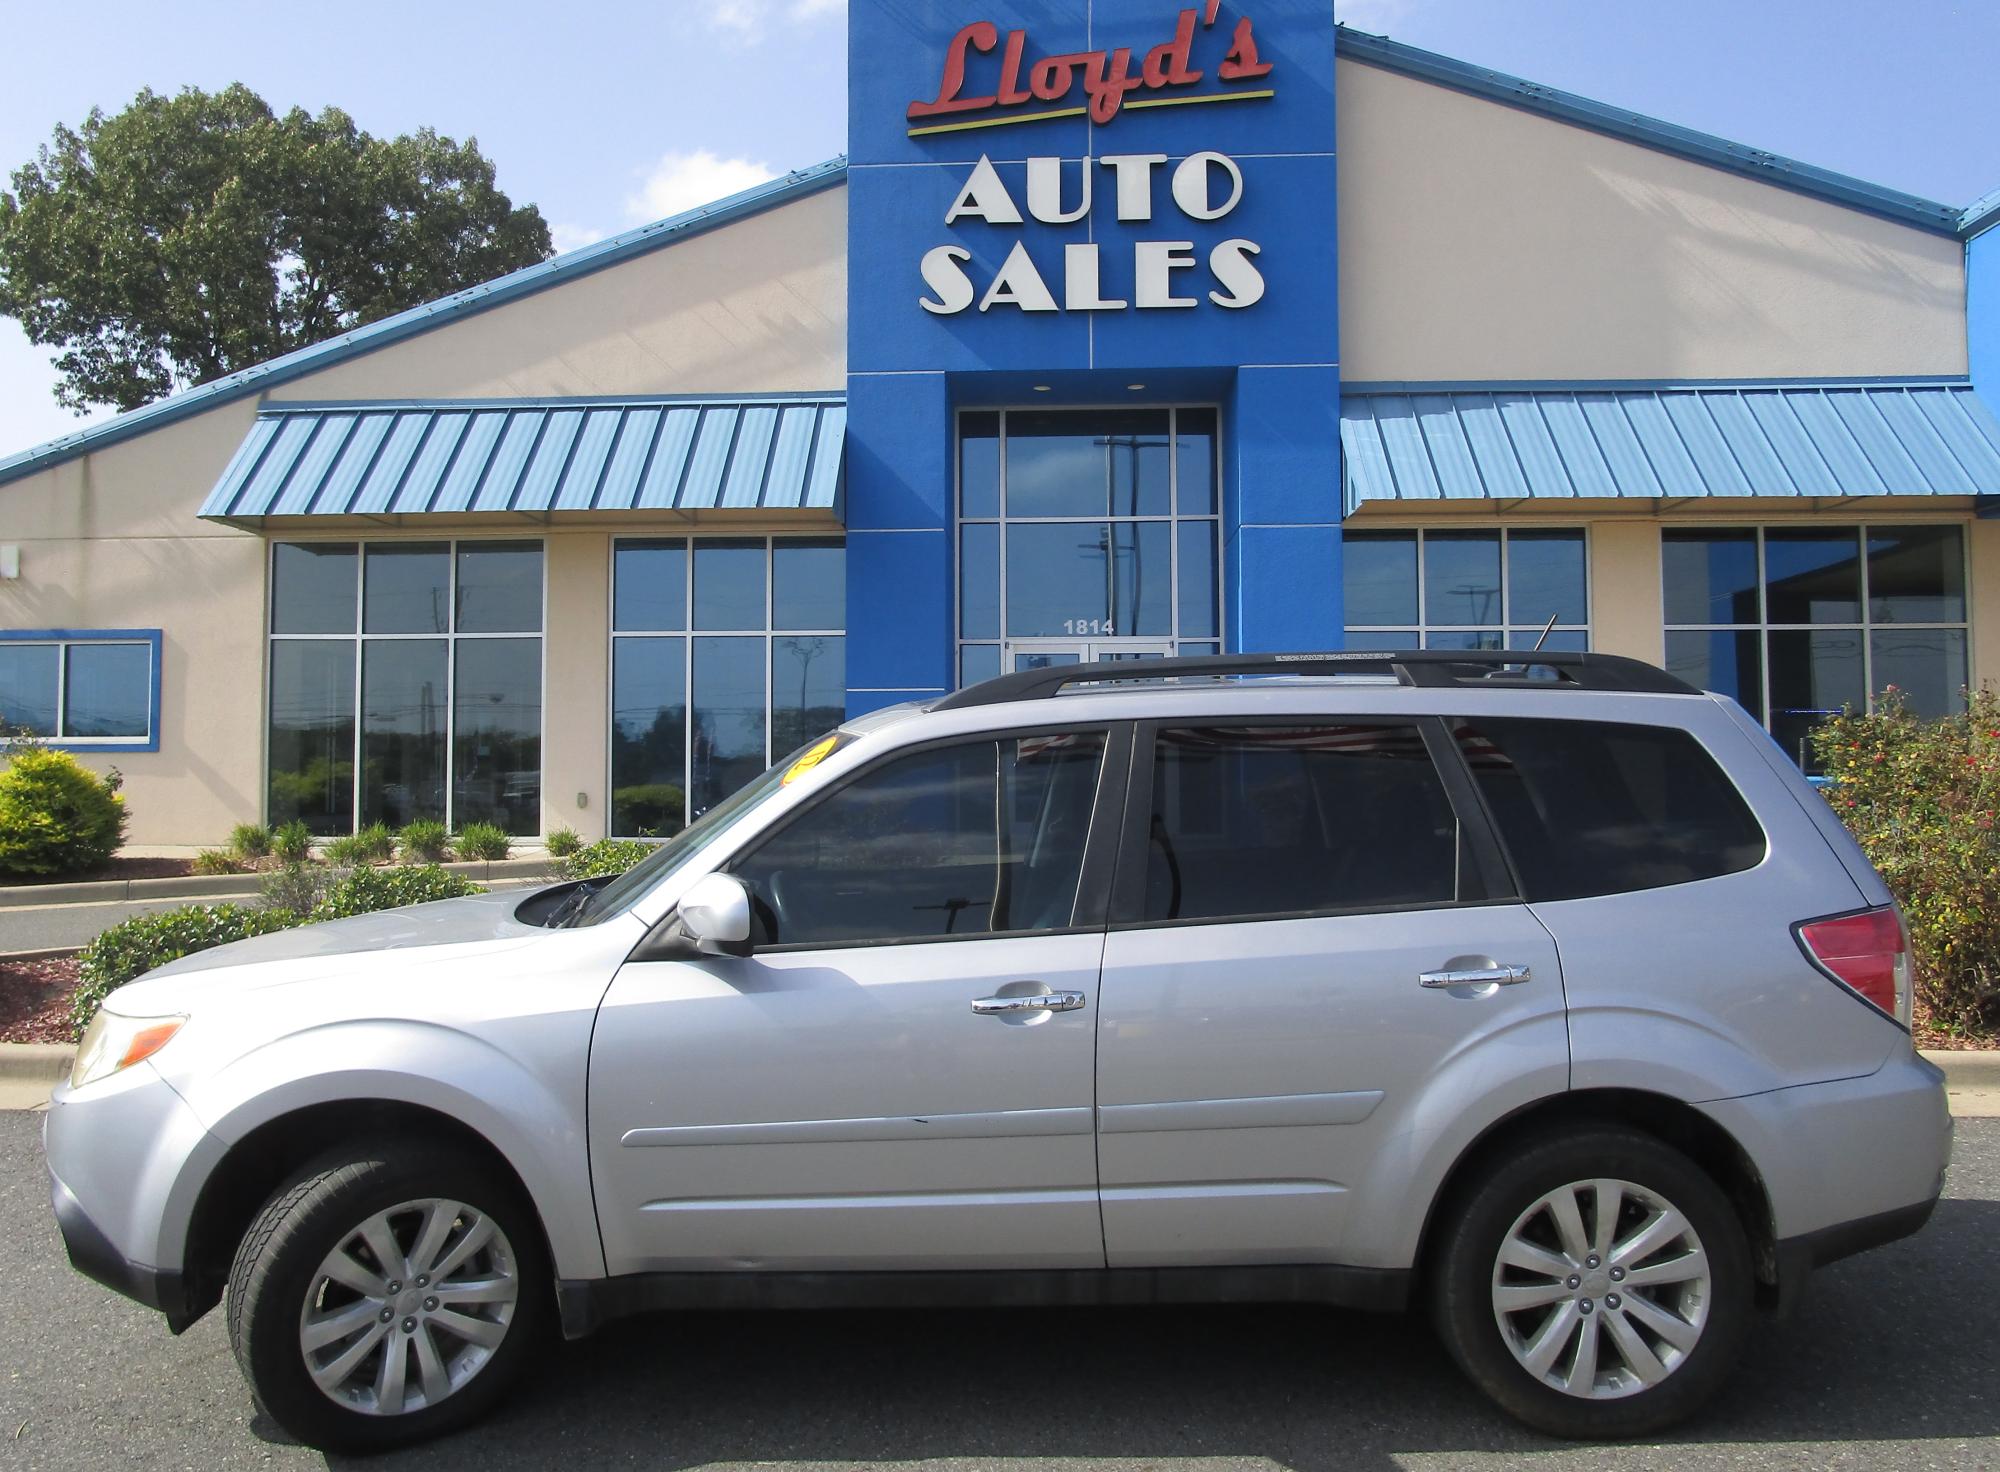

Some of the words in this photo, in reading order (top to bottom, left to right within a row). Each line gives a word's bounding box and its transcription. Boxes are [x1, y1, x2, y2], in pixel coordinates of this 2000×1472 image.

[906, 0, 1274, 126] Lloyd's
[944, 151, 1243, 224] AUTO
[918, 238, 1265, 314] SALES
[1063, 619, 1114, 635] 1814
